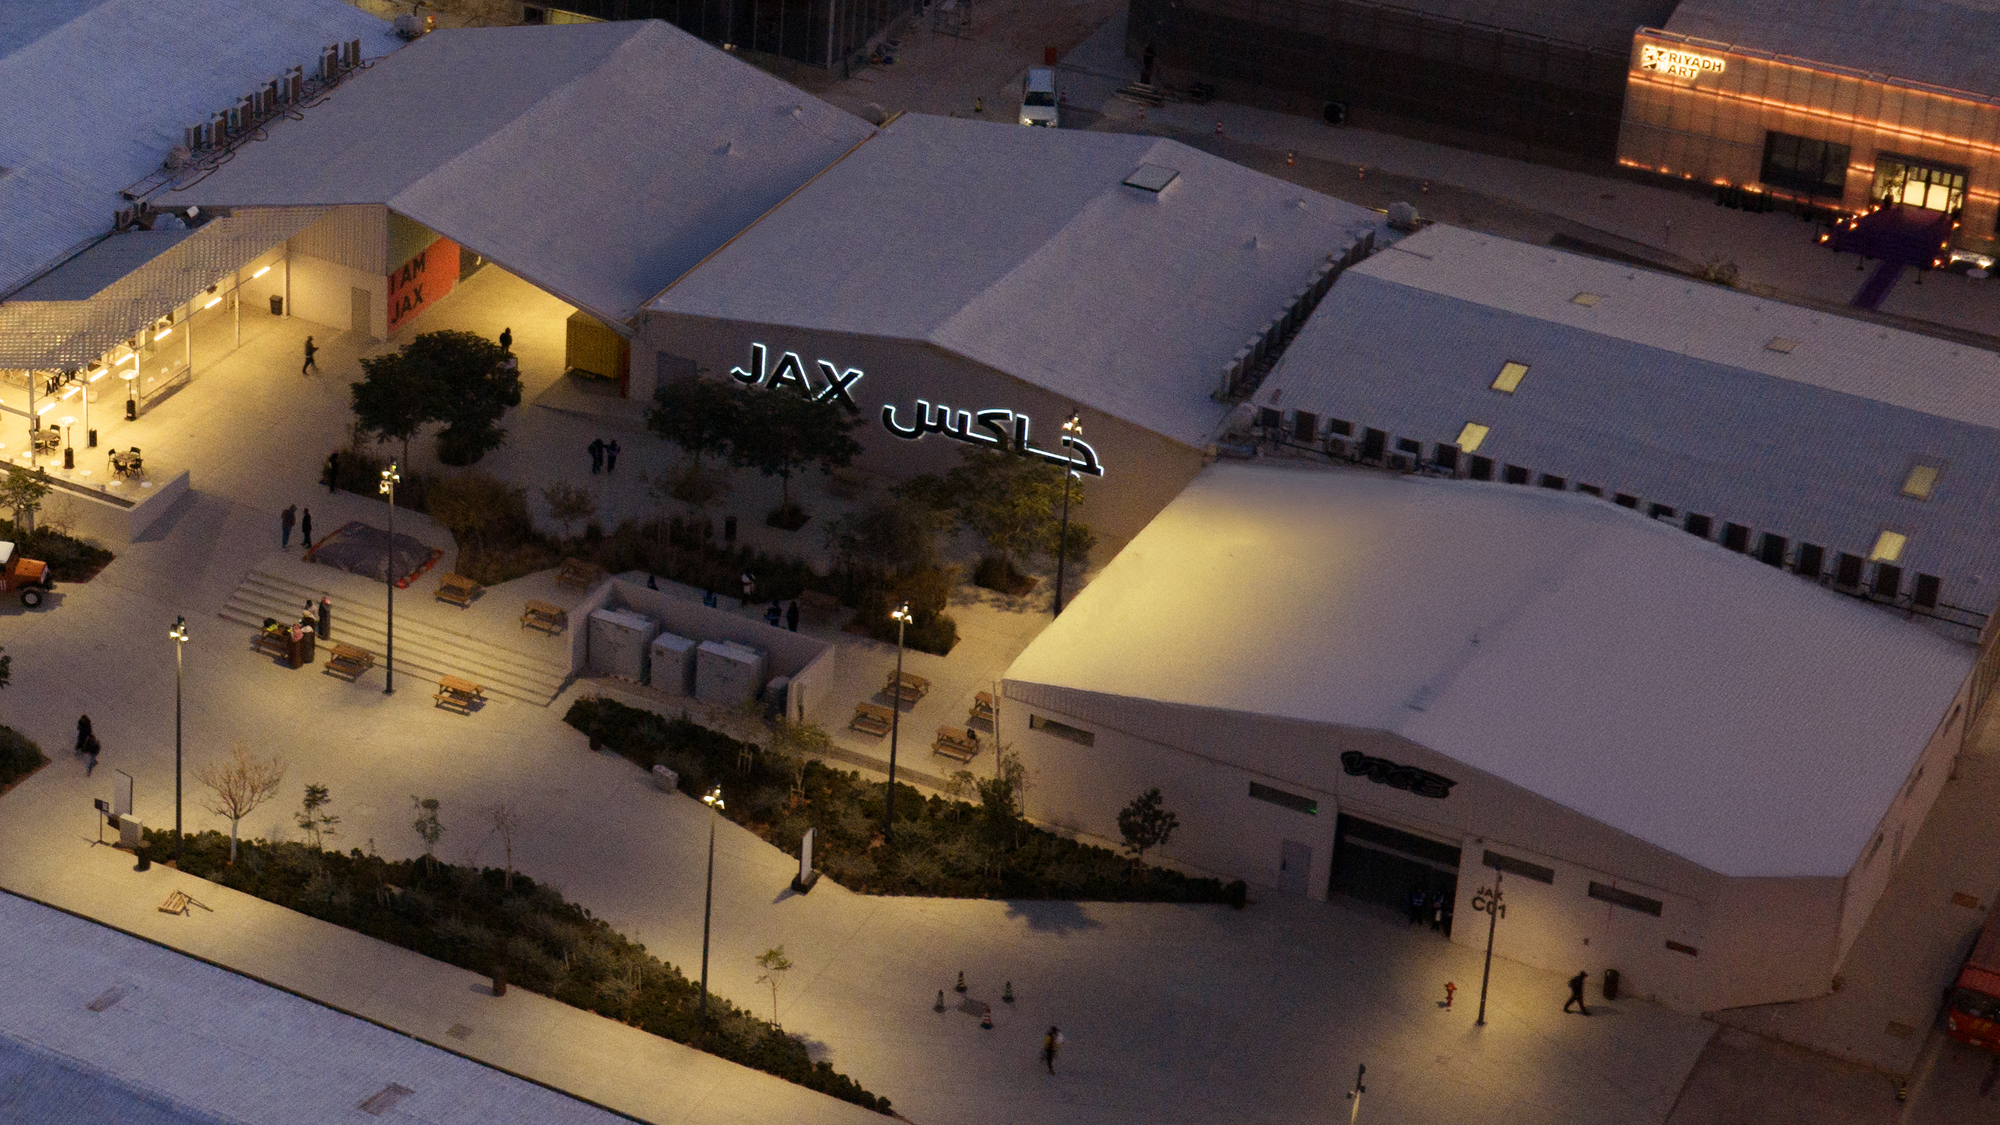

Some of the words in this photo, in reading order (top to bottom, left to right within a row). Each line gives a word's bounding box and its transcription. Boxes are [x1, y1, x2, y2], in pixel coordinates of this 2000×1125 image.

[1667, 64, 1698, 78] ART
[1669, 52, 1723, 72] RIYADH
[390, 273, 395, 295] I
[401, 251, 426, 290] AM
[391, 283, 423, 323] JAX
[730, 342, 864, 414] JAX
[1472, 897, 1506, 919] C01
